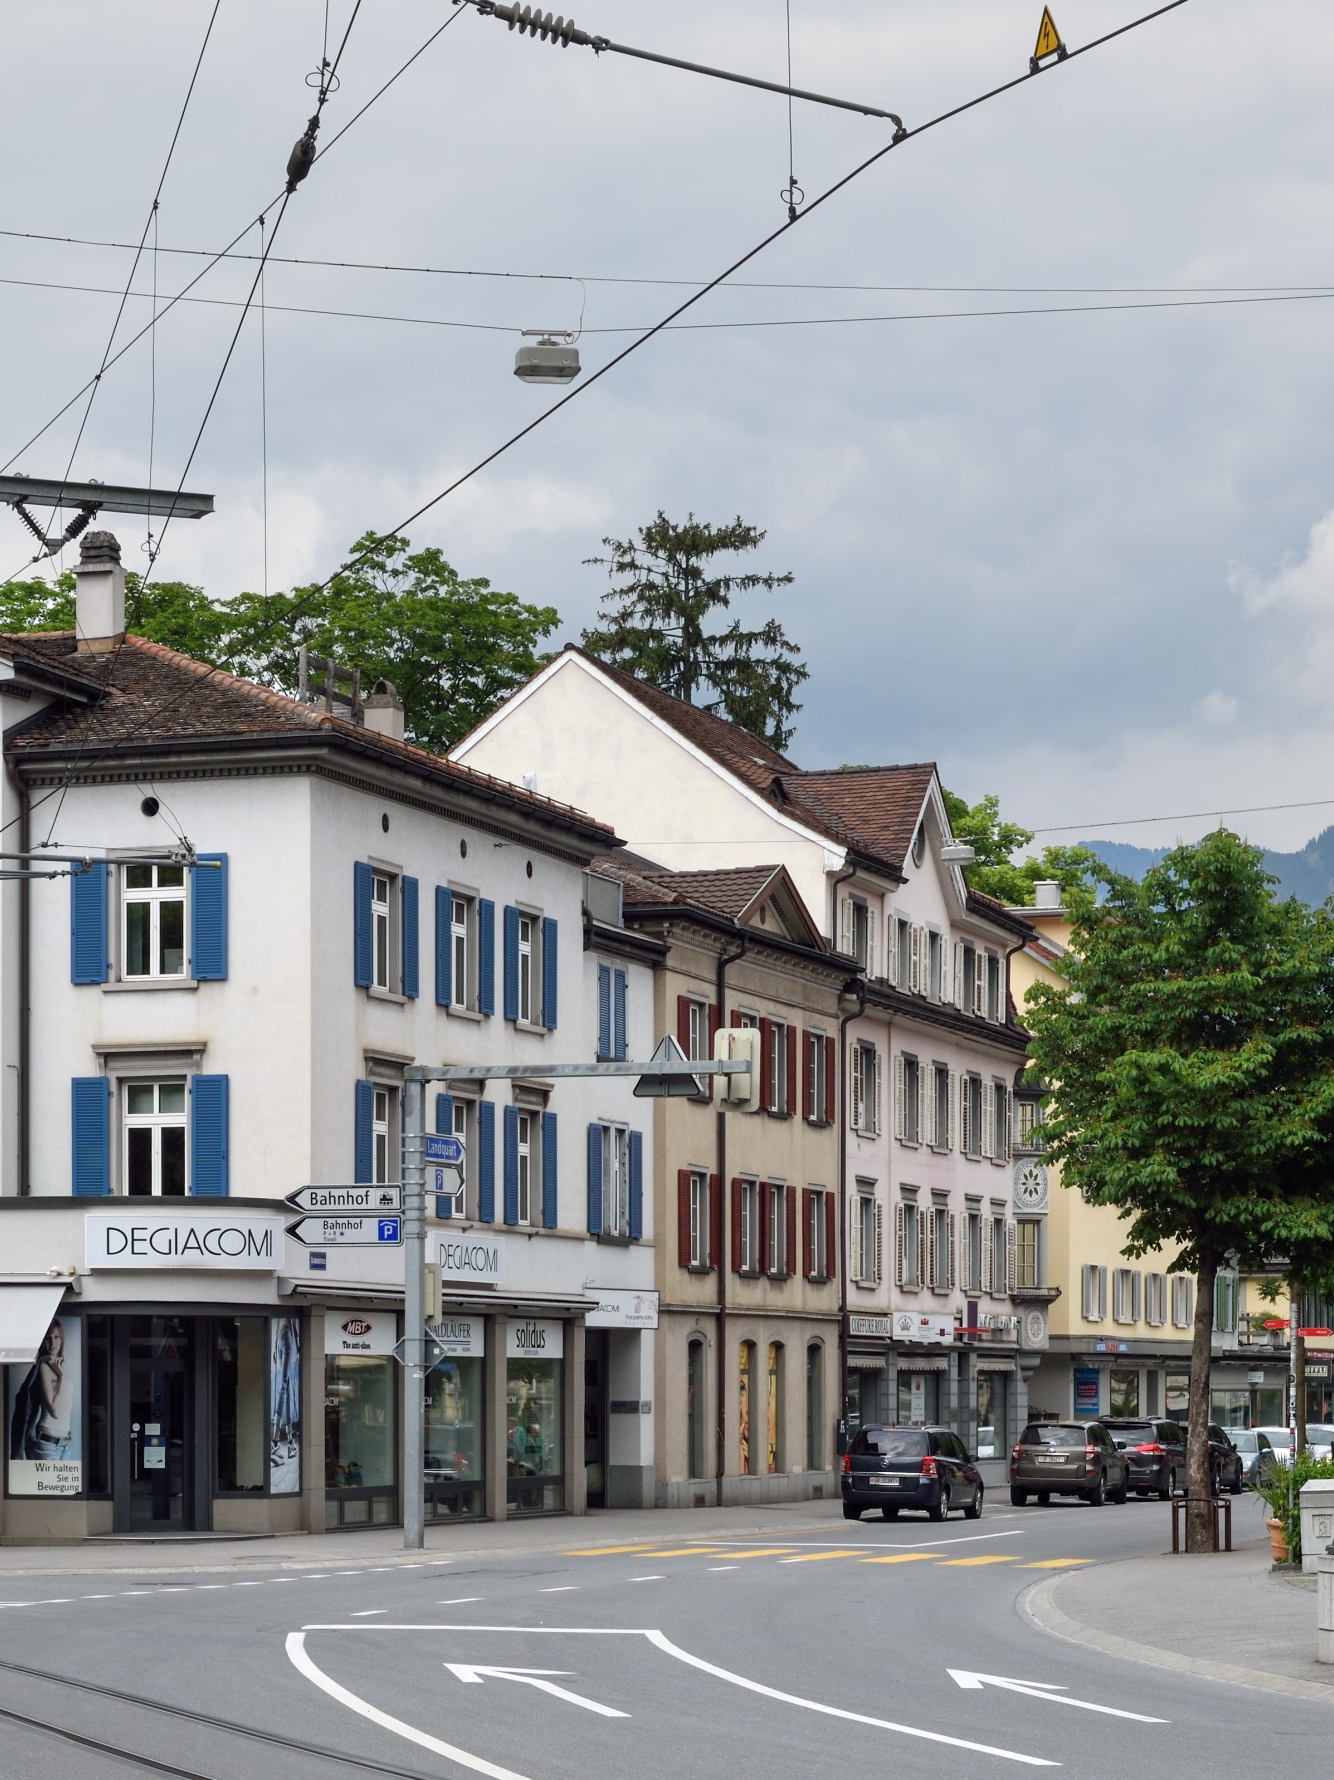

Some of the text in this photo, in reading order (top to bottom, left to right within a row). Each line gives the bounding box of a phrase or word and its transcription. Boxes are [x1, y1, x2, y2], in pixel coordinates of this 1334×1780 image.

[427, 1140, 457, 1159] Landquart
[310, 1190, 370, 1206] Bahnhof
[323, 1219, 363, 1230] Bahnhof
[106, 1226, 273, 1258] DEGIACOMI
[439, 1243, 499, 1273] DEGIACOMI
[346, 1320, 365, 1334] MBT
[852, 1318, 874, 1333] COIFFURE
[875, 1319, 889, 1334] ROYAL
[516, 1322, 546, 1348] solidus
[342, 1341, 351, 1350] The
[35, 1463, 79, 1472] Wir halten
[38, 1482, 79, 1493] Bewegung
